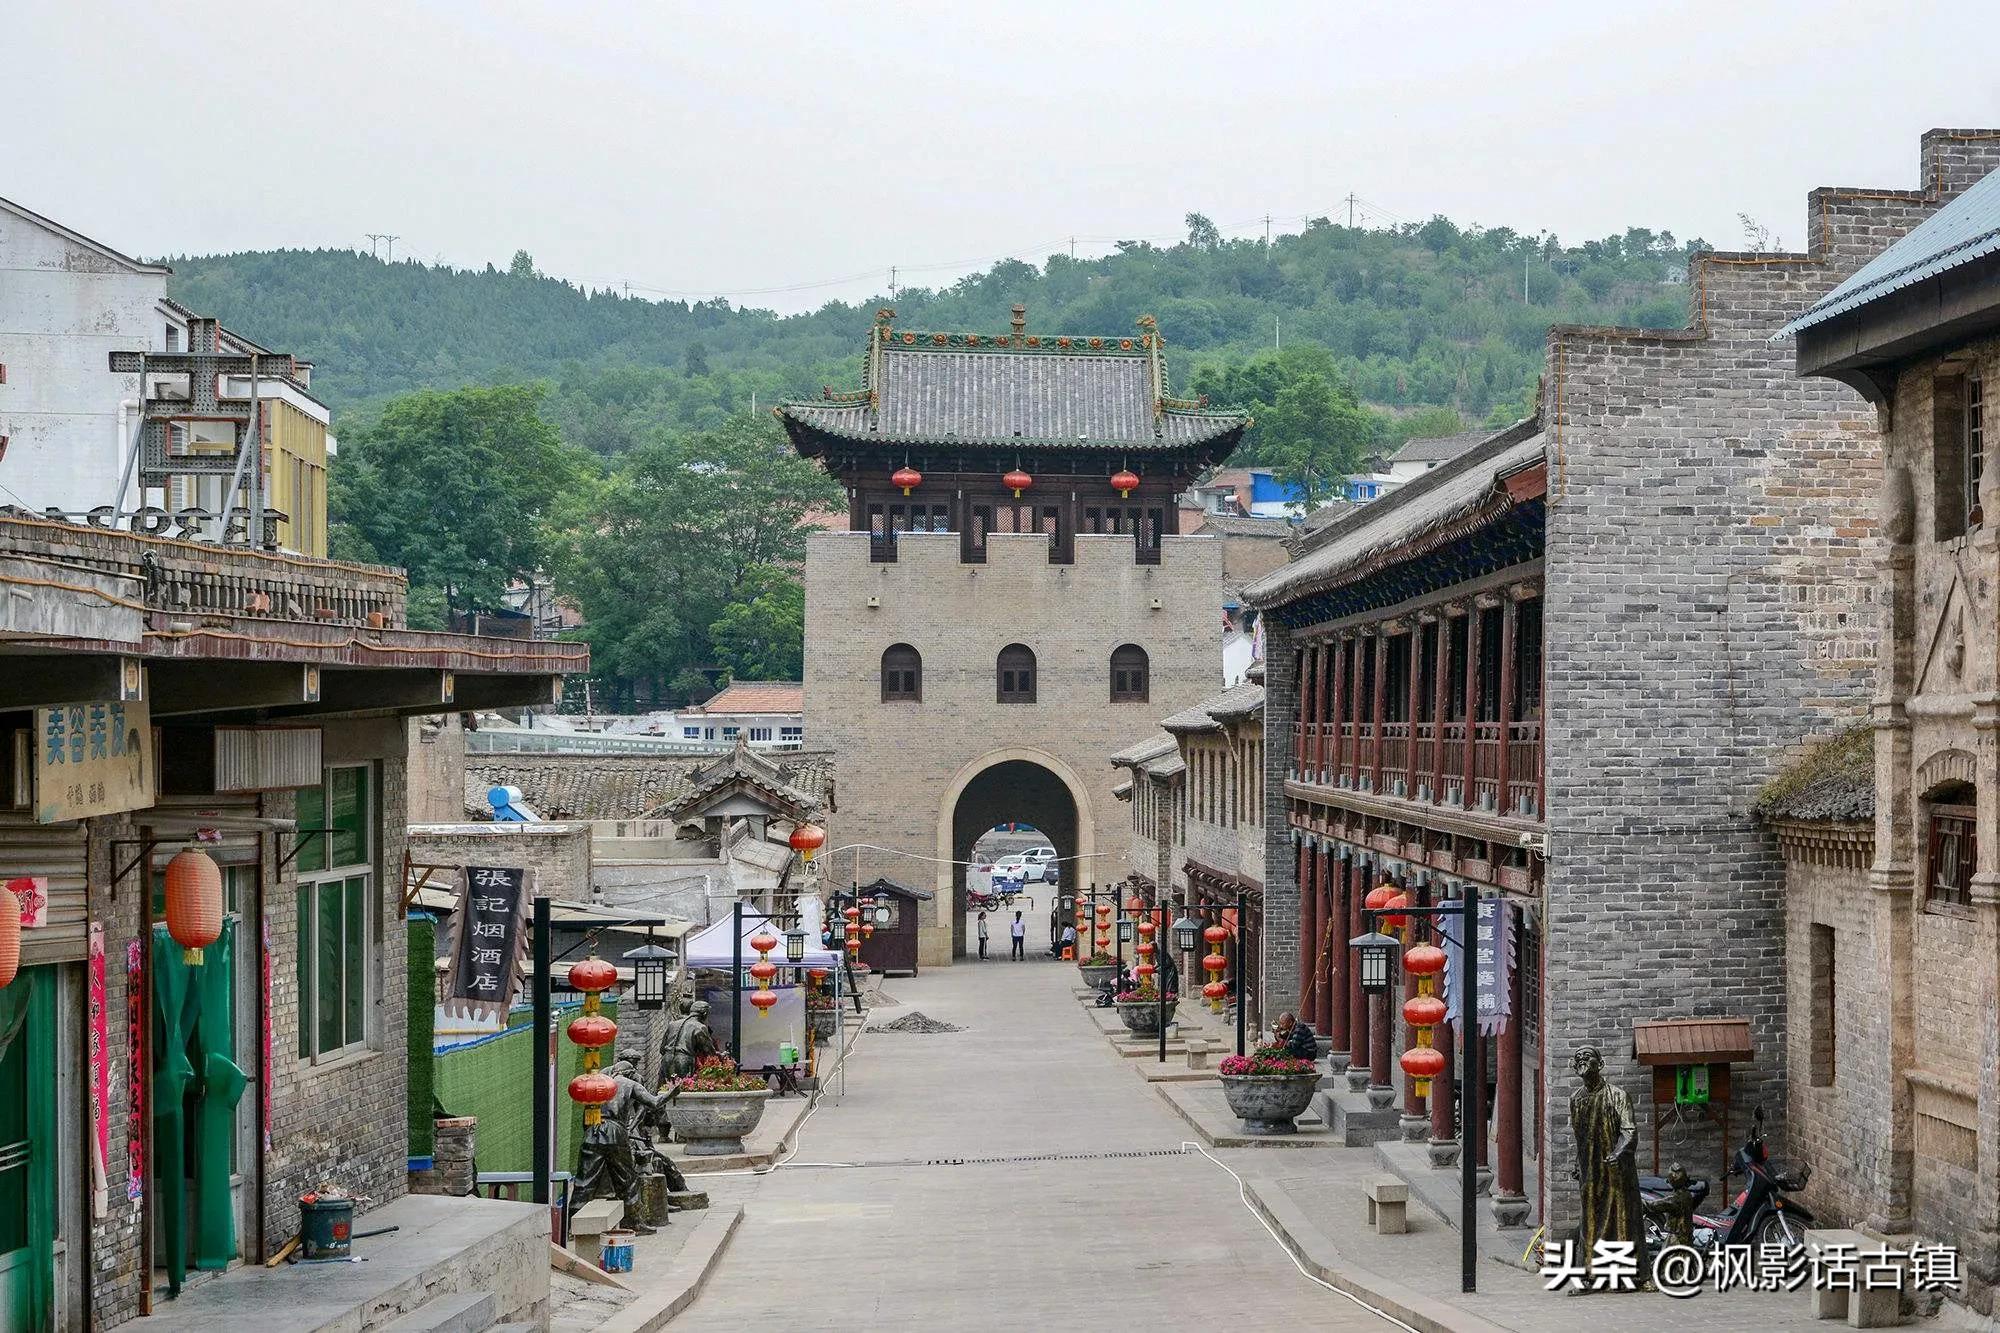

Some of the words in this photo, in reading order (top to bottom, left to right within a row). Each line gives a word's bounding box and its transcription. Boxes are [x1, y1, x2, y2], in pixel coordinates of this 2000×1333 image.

[467, 869, 513, 991] 張記烟酒店
